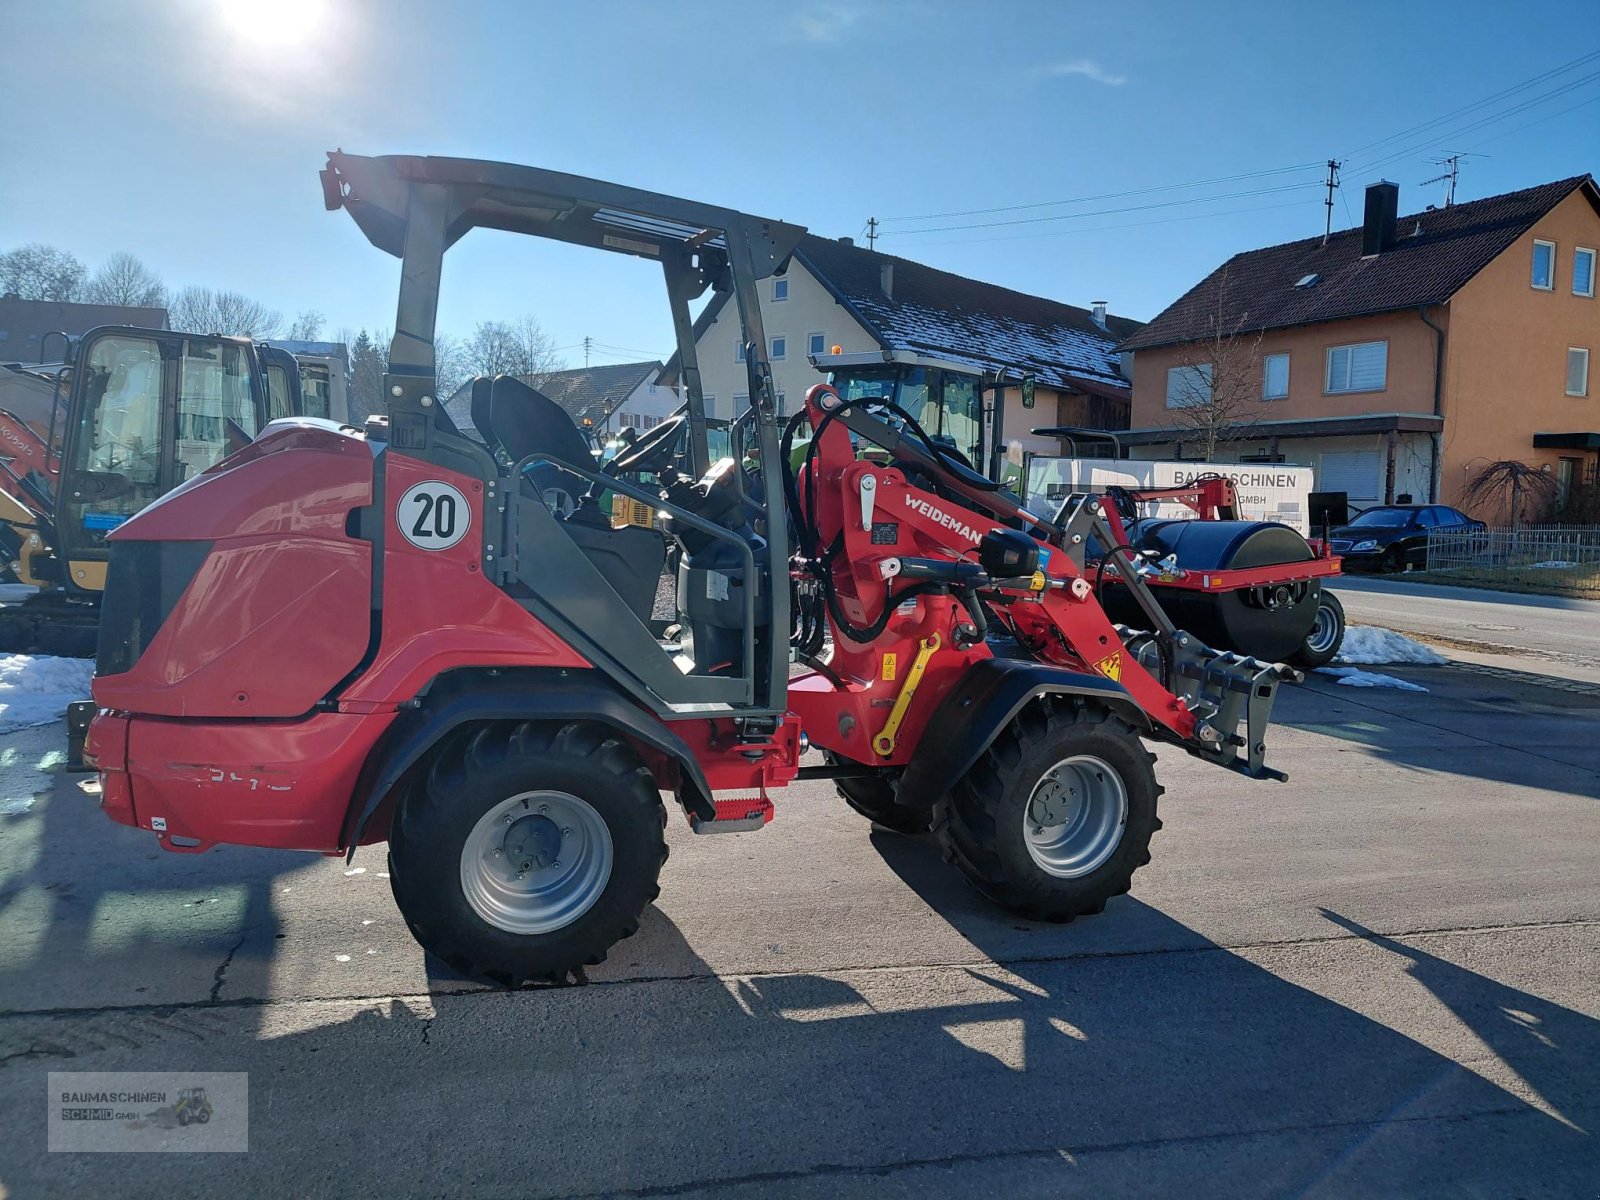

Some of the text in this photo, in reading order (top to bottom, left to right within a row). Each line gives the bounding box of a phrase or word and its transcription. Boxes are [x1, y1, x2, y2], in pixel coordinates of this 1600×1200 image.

[1174, 471, 1297, 488] BASCHINEN
[412, 492, 456, 538] 20
[1239, 495, 1267, 505] GMBH
[905, 493, 983, 546] WEIDEMAN
